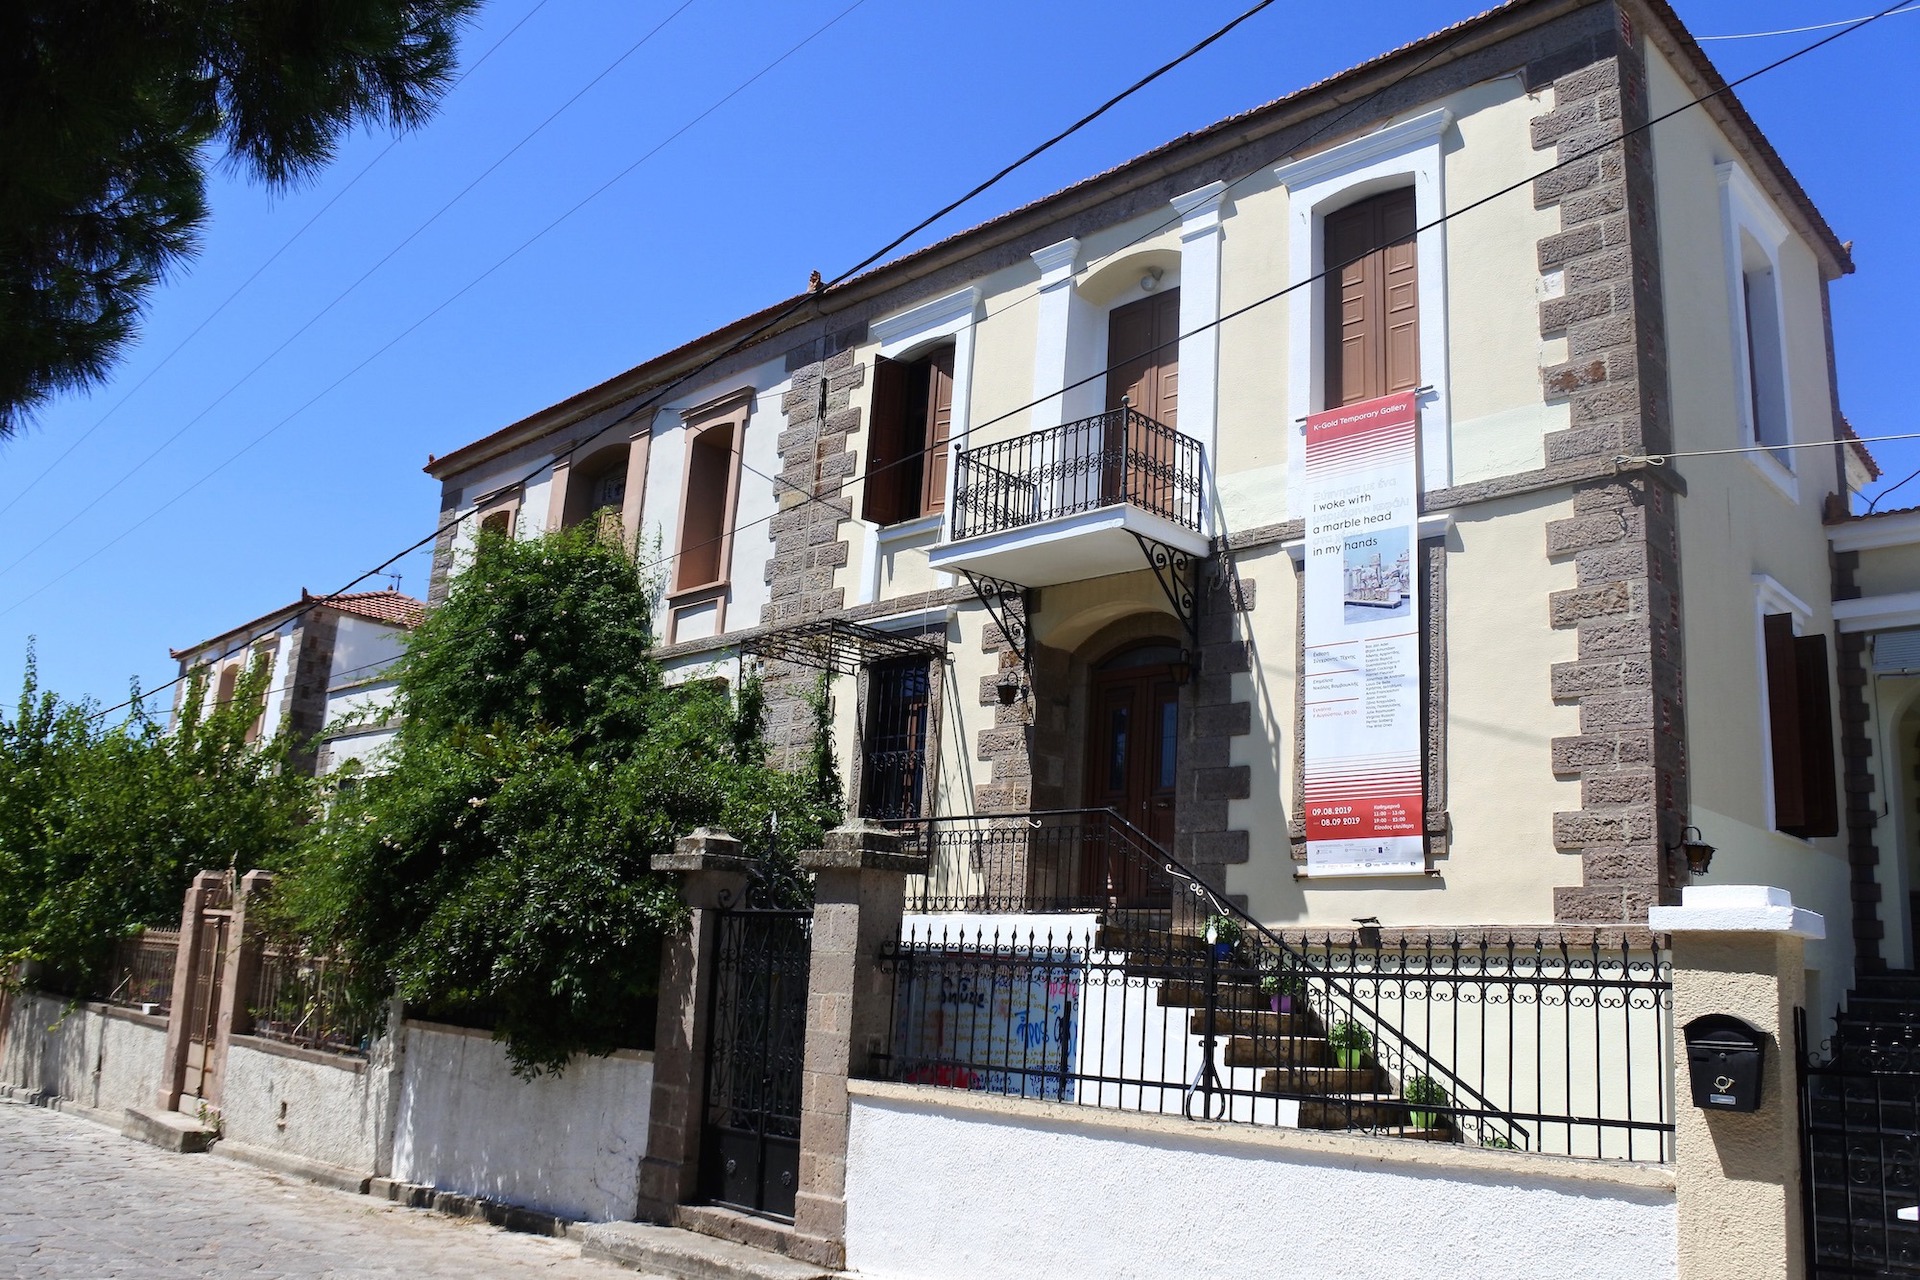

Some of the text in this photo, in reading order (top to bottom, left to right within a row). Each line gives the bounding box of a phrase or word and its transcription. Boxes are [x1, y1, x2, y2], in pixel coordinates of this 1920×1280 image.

[1313, 403, 1407, 431] K-Gold Temporary Gallery
[1318, 499, 1345, 511] woke
[1348, 493, 1371, 505] with
[1312, 511, 1392, 535] a marble head
[1313, 537, 1378, 556] in my hands
[1312, 806, 1353, 816] 09.08.2019
[1320, 817, 1361, 827] 08.092019
